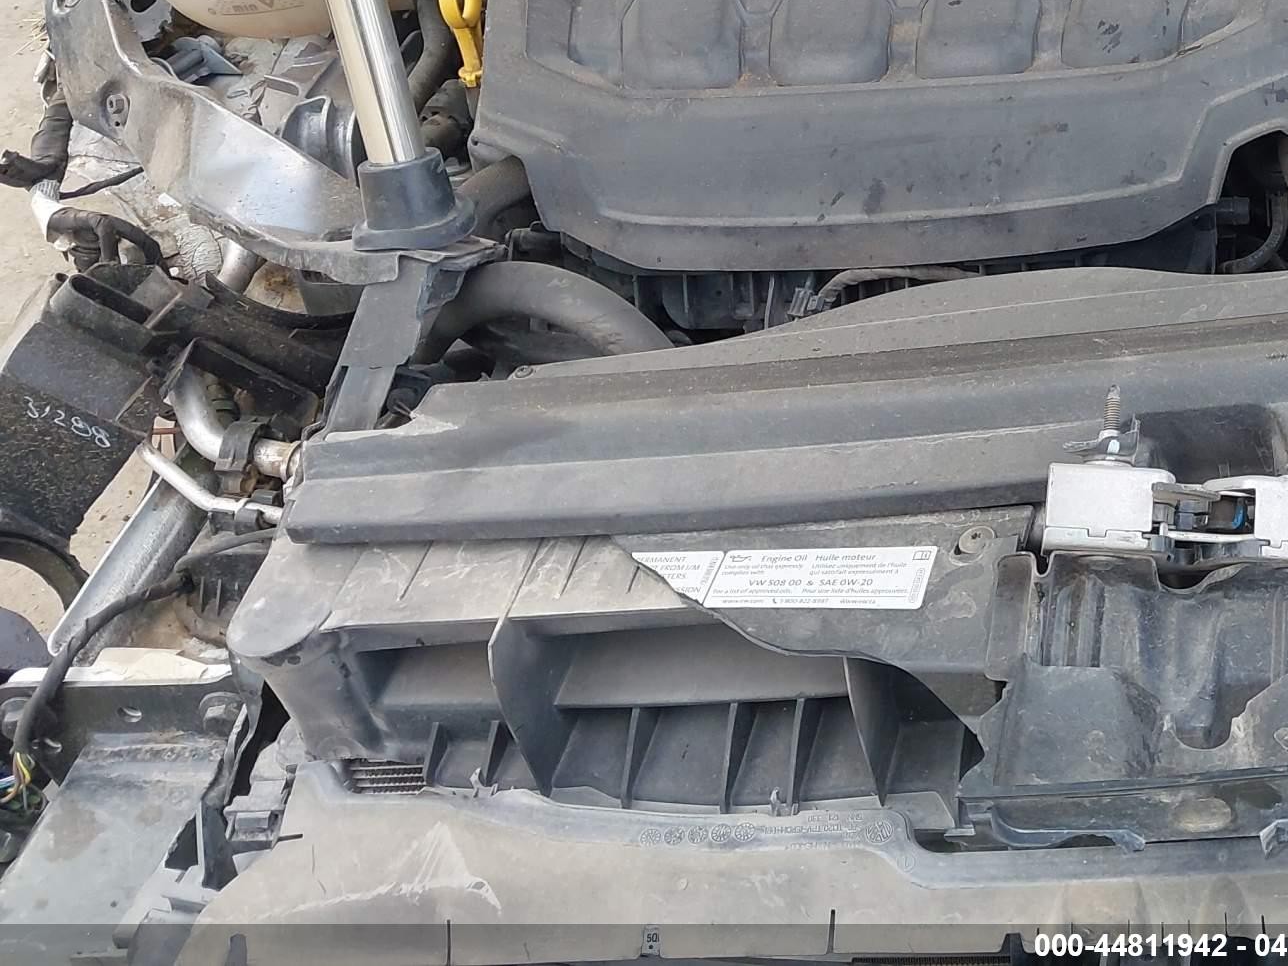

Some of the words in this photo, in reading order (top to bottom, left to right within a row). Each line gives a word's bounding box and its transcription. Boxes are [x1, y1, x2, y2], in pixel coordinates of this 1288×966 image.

[761, 554, 792, 563] Engine
[794, 554, 808, 562] Oil
[815, 553, 840, 561] Huile
[819, 578, 839, 586] SAE
[840, 578, 873, 586] 0W-20
